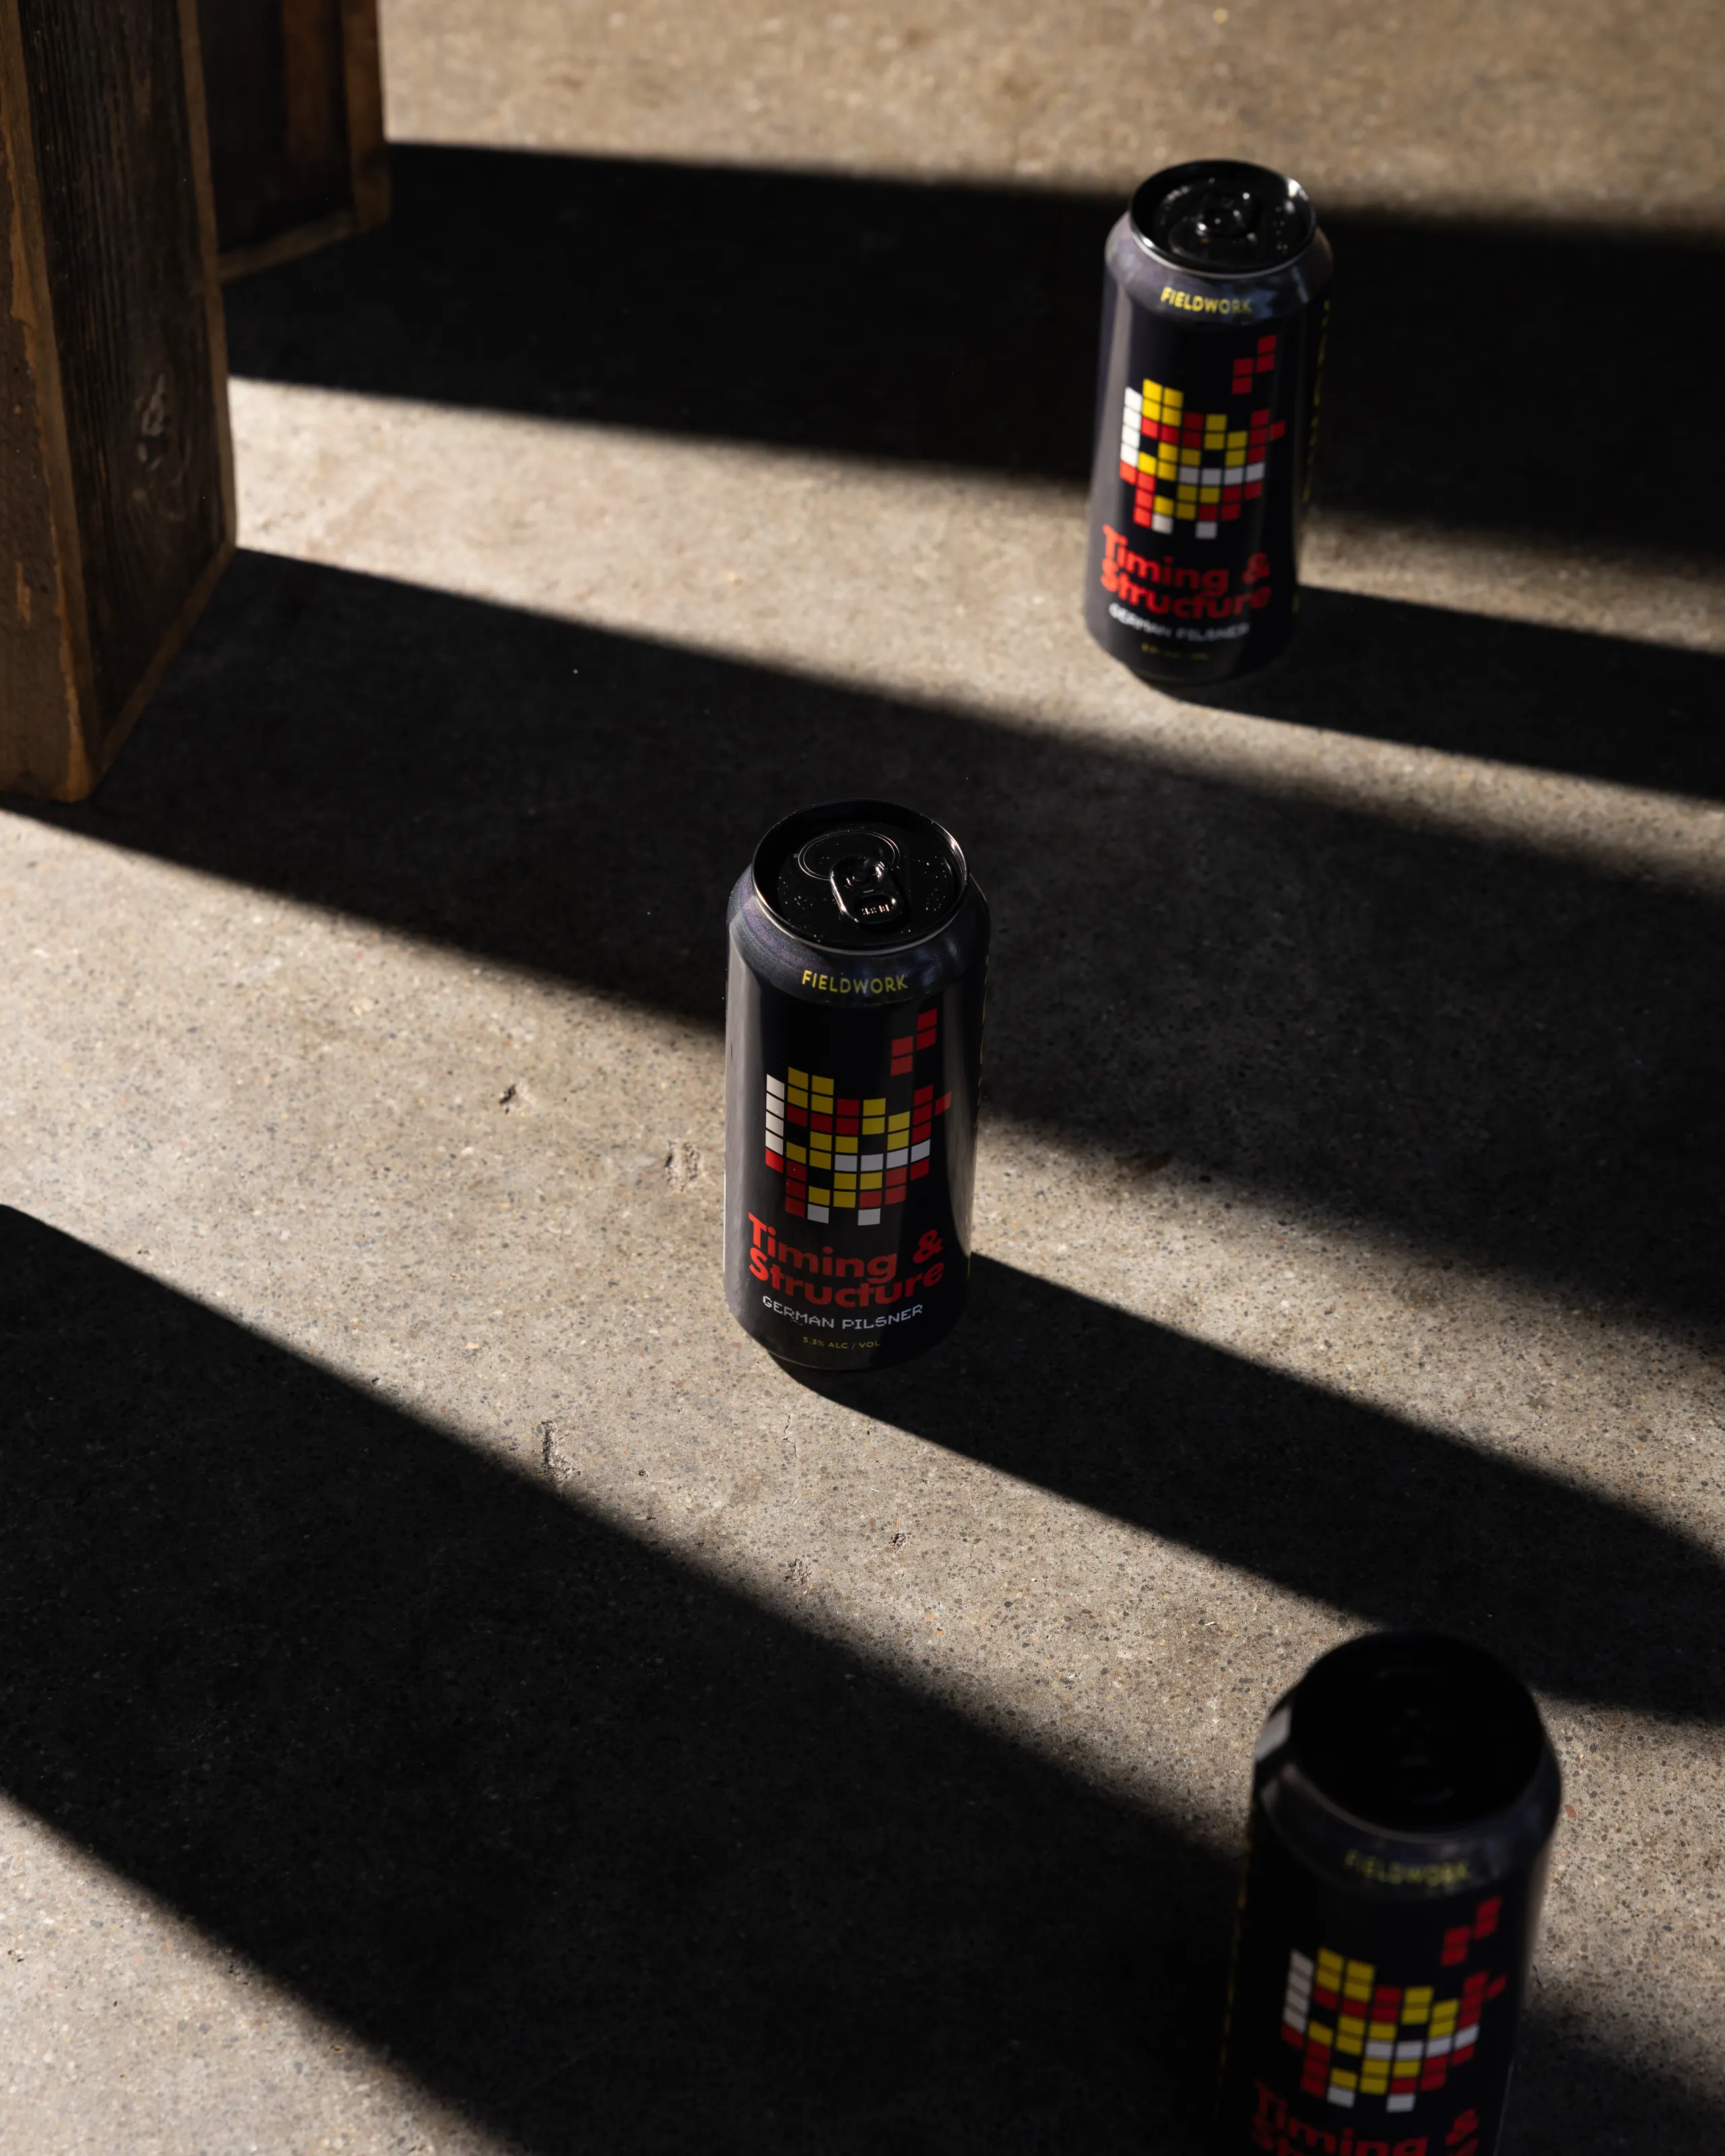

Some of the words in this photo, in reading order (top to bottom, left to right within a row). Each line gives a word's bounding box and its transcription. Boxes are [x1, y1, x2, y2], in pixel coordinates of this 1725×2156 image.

[1160, 287, 1252, 314] FIELDWORK
[1102, 524, 1228, 596] Timing
[1242, 551, 1271, 583] &
[1101, 557, 1272, 619] Structure
[802, 970, 908, 994] FIELDWORK
[749, 1212, 897, 1283] Timing
[912, 1229, 943, 1263] &
[749, 1247, 944, 1308] Structure
[763, 1296, 834, 1329] GERMAN
[842, 1304, 923, 1329] PILSNER
[1344, 1848, 1470, 1885] FIELDWORK
[1445, 2107, 1479, 2146] &
